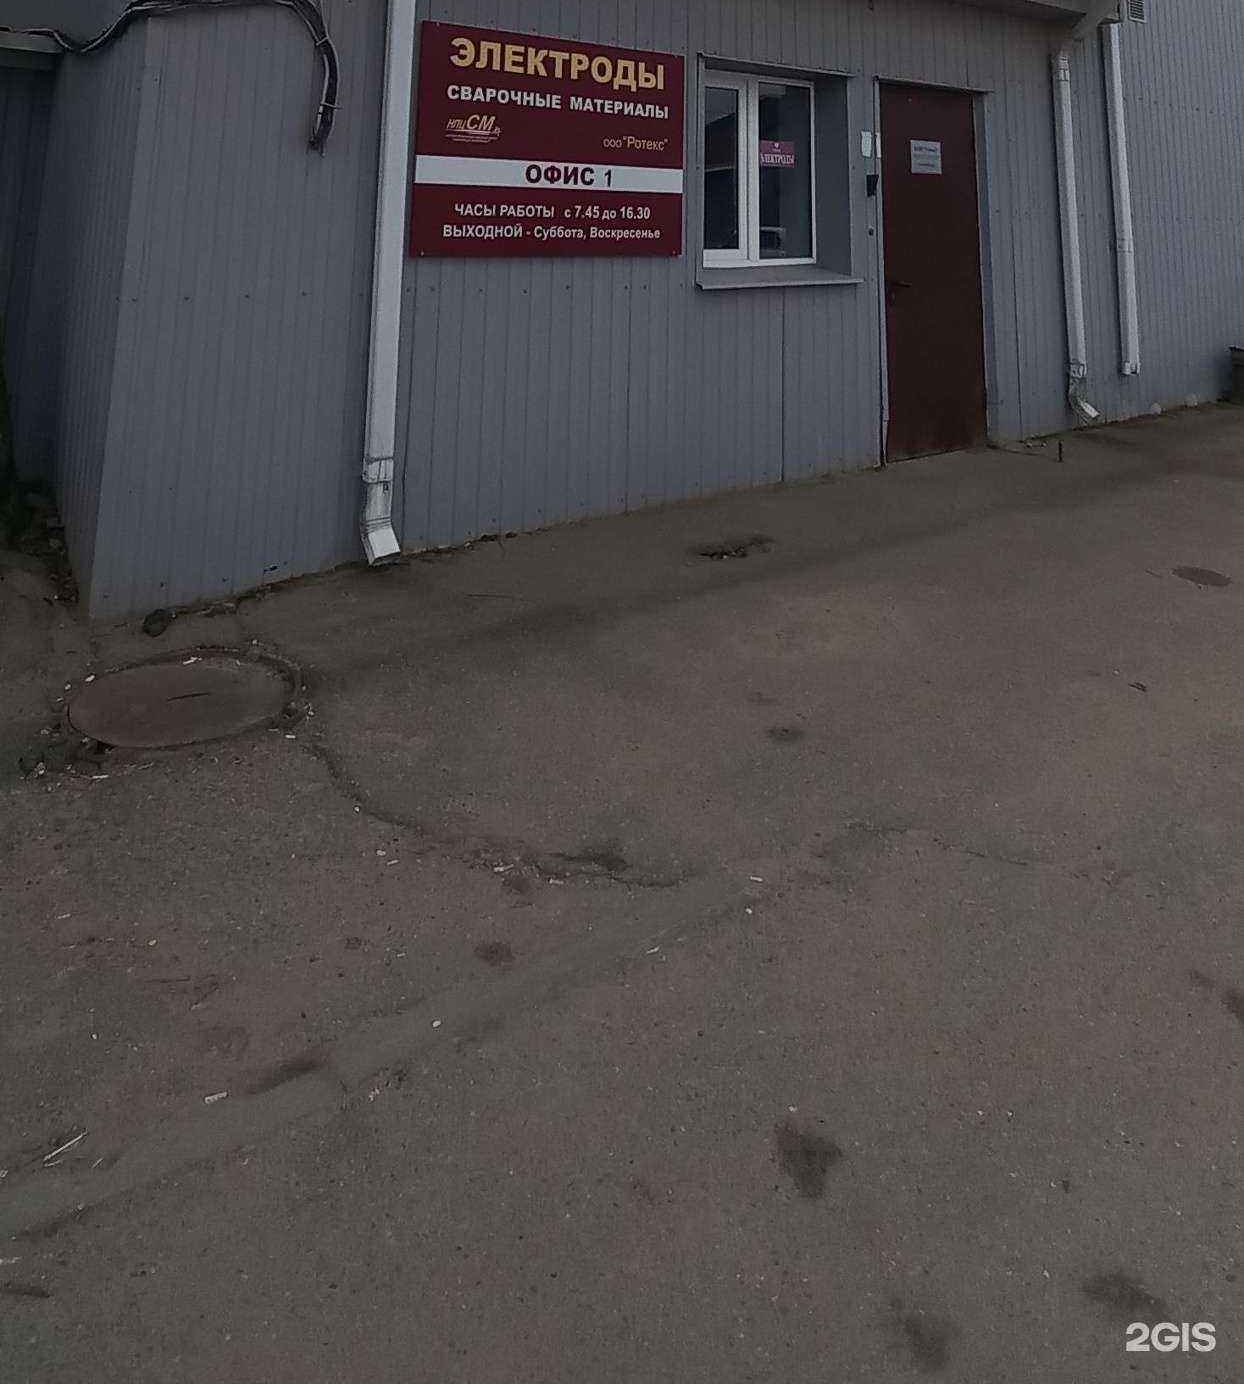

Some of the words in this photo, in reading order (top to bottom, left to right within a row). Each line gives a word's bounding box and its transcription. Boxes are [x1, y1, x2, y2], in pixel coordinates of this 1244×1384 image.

[449, 37, 665, 92] ЭЛЕКТРОДЫ
[447, 84, 562, 109] СВАРОЧНЫЕ
[569, 96, 669, 119] МАТЕРИАЛЫ
[525, 164, 595, 186] ОФИС
[604, 169, 612, 187] 1
[454, 203, 496, 217] ЧАСЫ
[499, 204, 555, 218] РАБОТЫ
[574, 205, 600, 219] 7.45
[601, 209, 617, 220] до
[620, 206, 651, 219] 16.30
[442, 223, 523, 240] ВЫХОДНОЙ
[534, 225, 587, 241] Суббота,
[589, 226, 661, 241] Воскресенье
